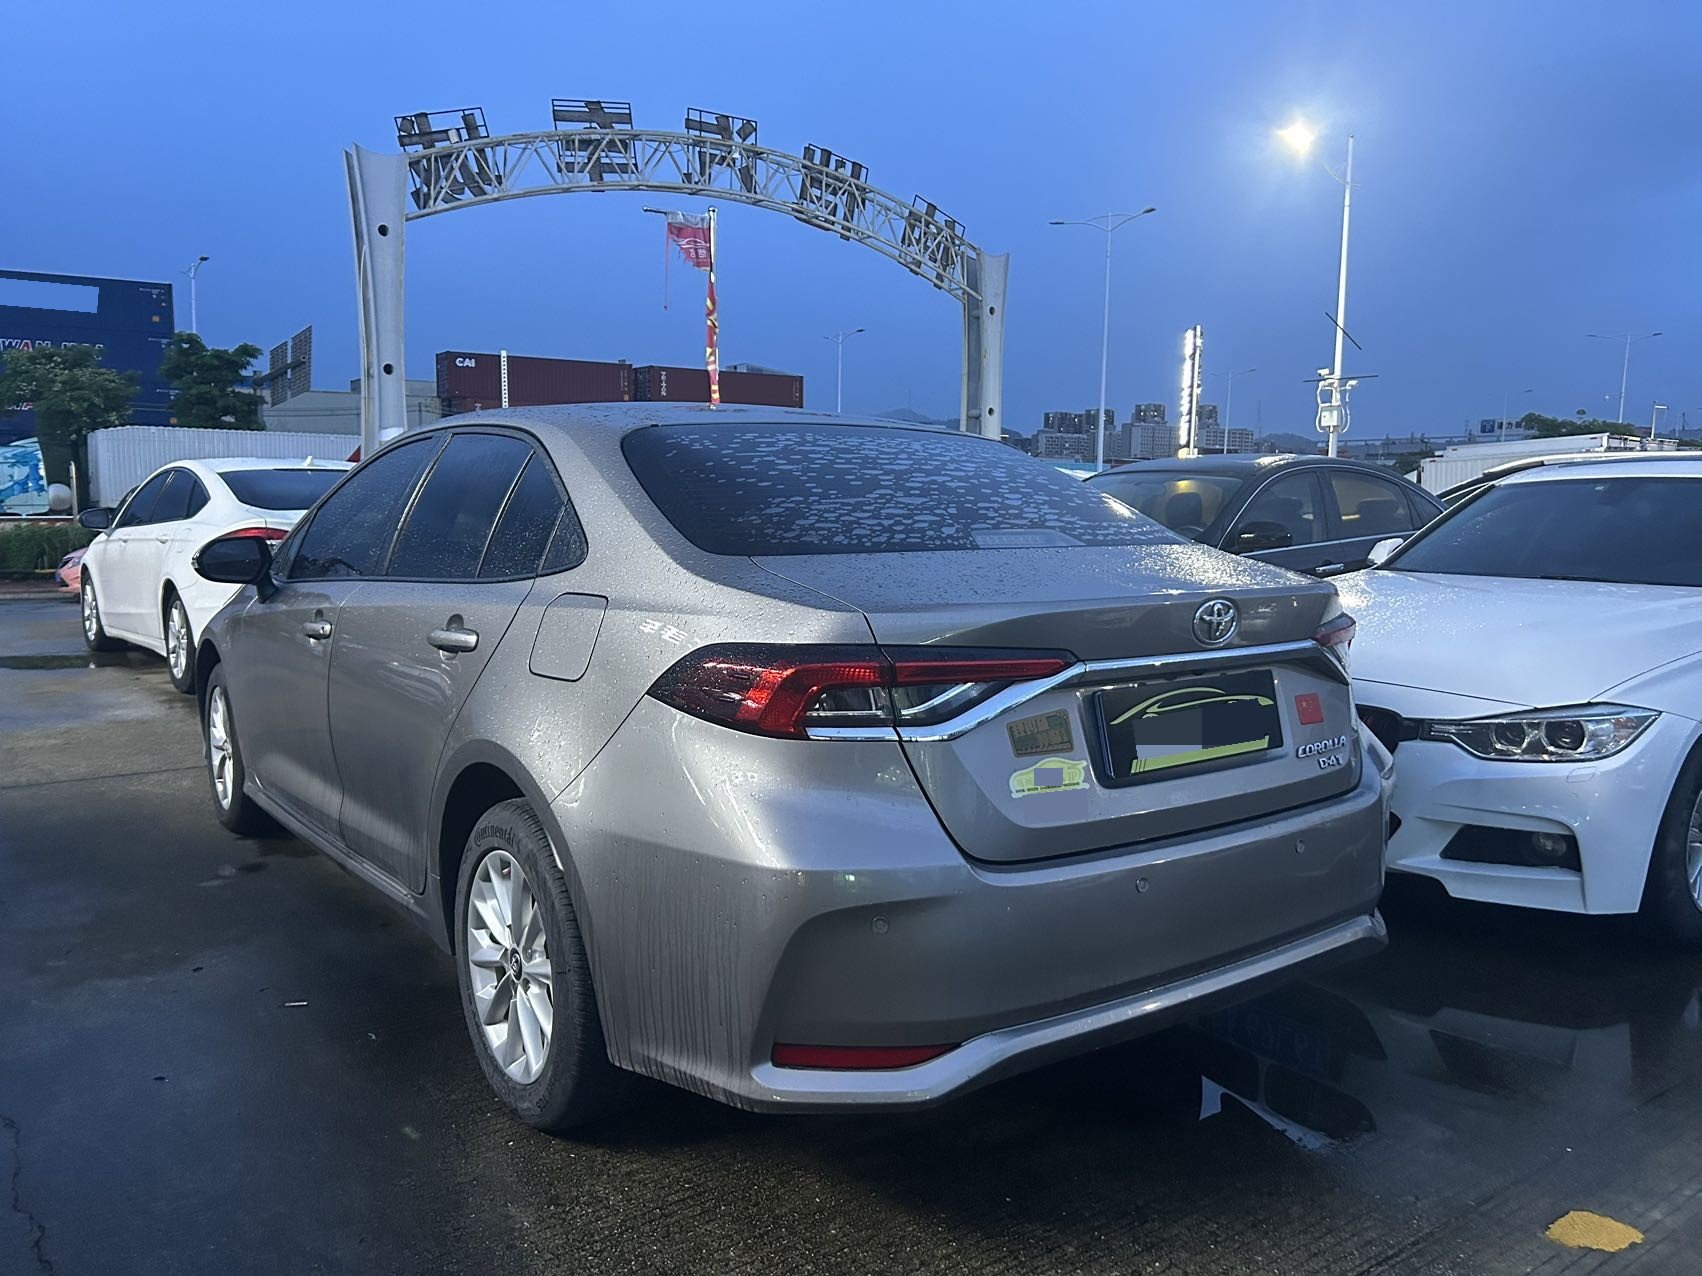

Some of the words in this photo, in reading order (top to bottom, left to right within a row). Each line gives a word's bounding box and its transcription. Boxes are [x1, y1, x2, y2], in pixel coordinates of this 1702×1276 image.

[455, 357, 475, 367] CAI
[1296, 735, 1346, 758] COROLLA
[474, 822, 516, 848] Continental
